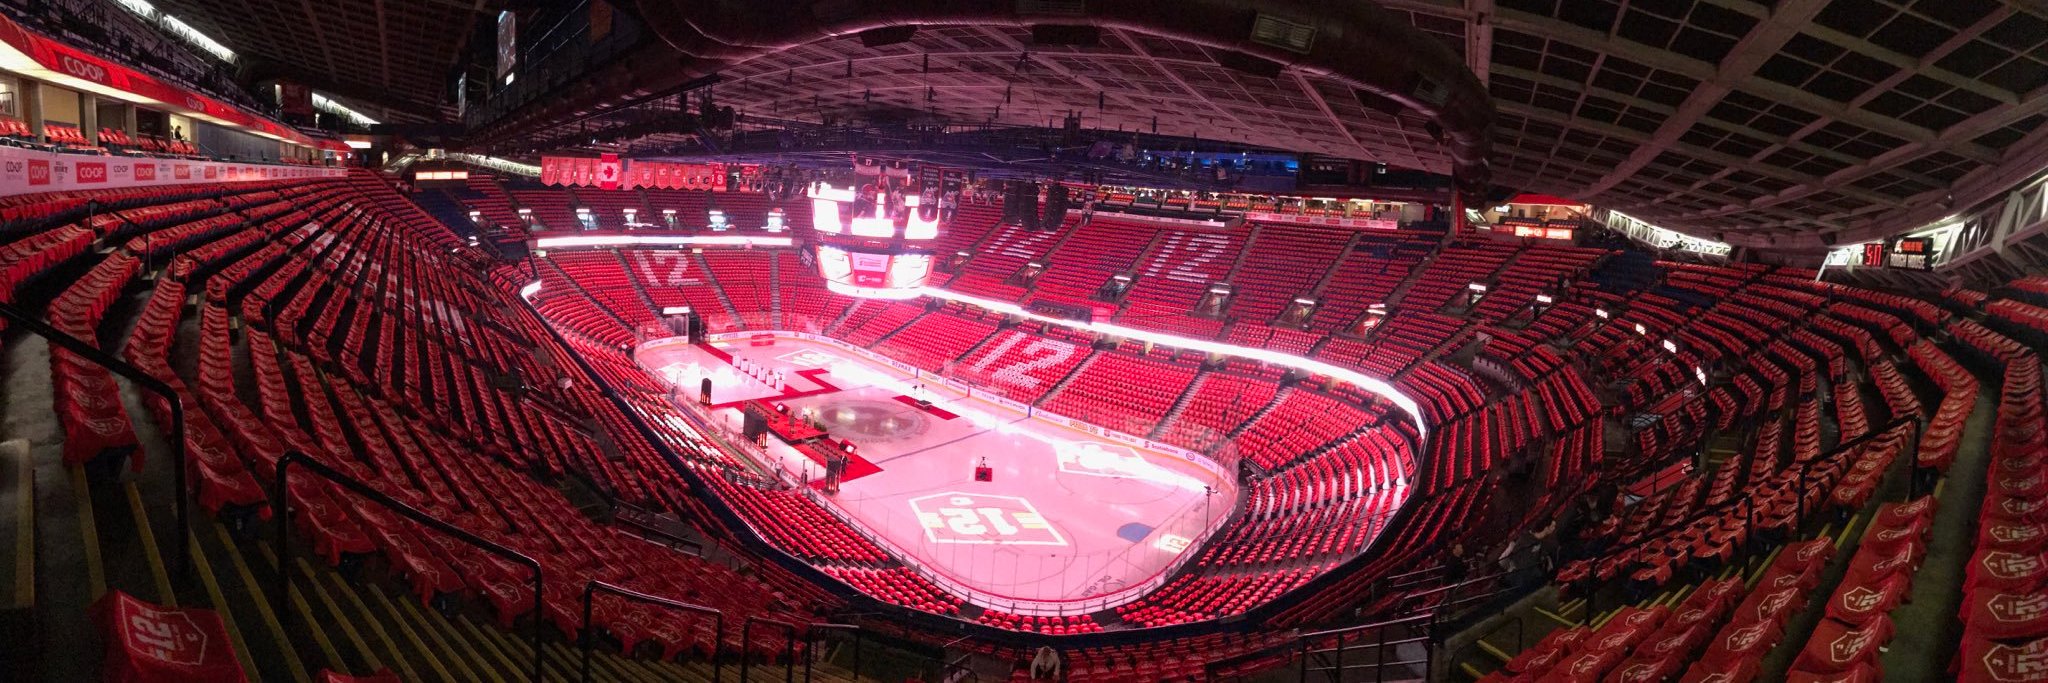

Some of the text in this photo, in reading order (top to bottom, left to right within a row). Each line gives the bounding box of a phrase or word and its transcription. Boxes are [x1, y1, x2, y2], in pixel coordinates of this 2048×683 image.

[80, 167, 104, 178] CO-OP
[632, 249, 700, 287] 12
[1144, 231, 1231, 283] 12
[972, 331, 1075, 390] 12
[131, 616, 175, 650] 12
